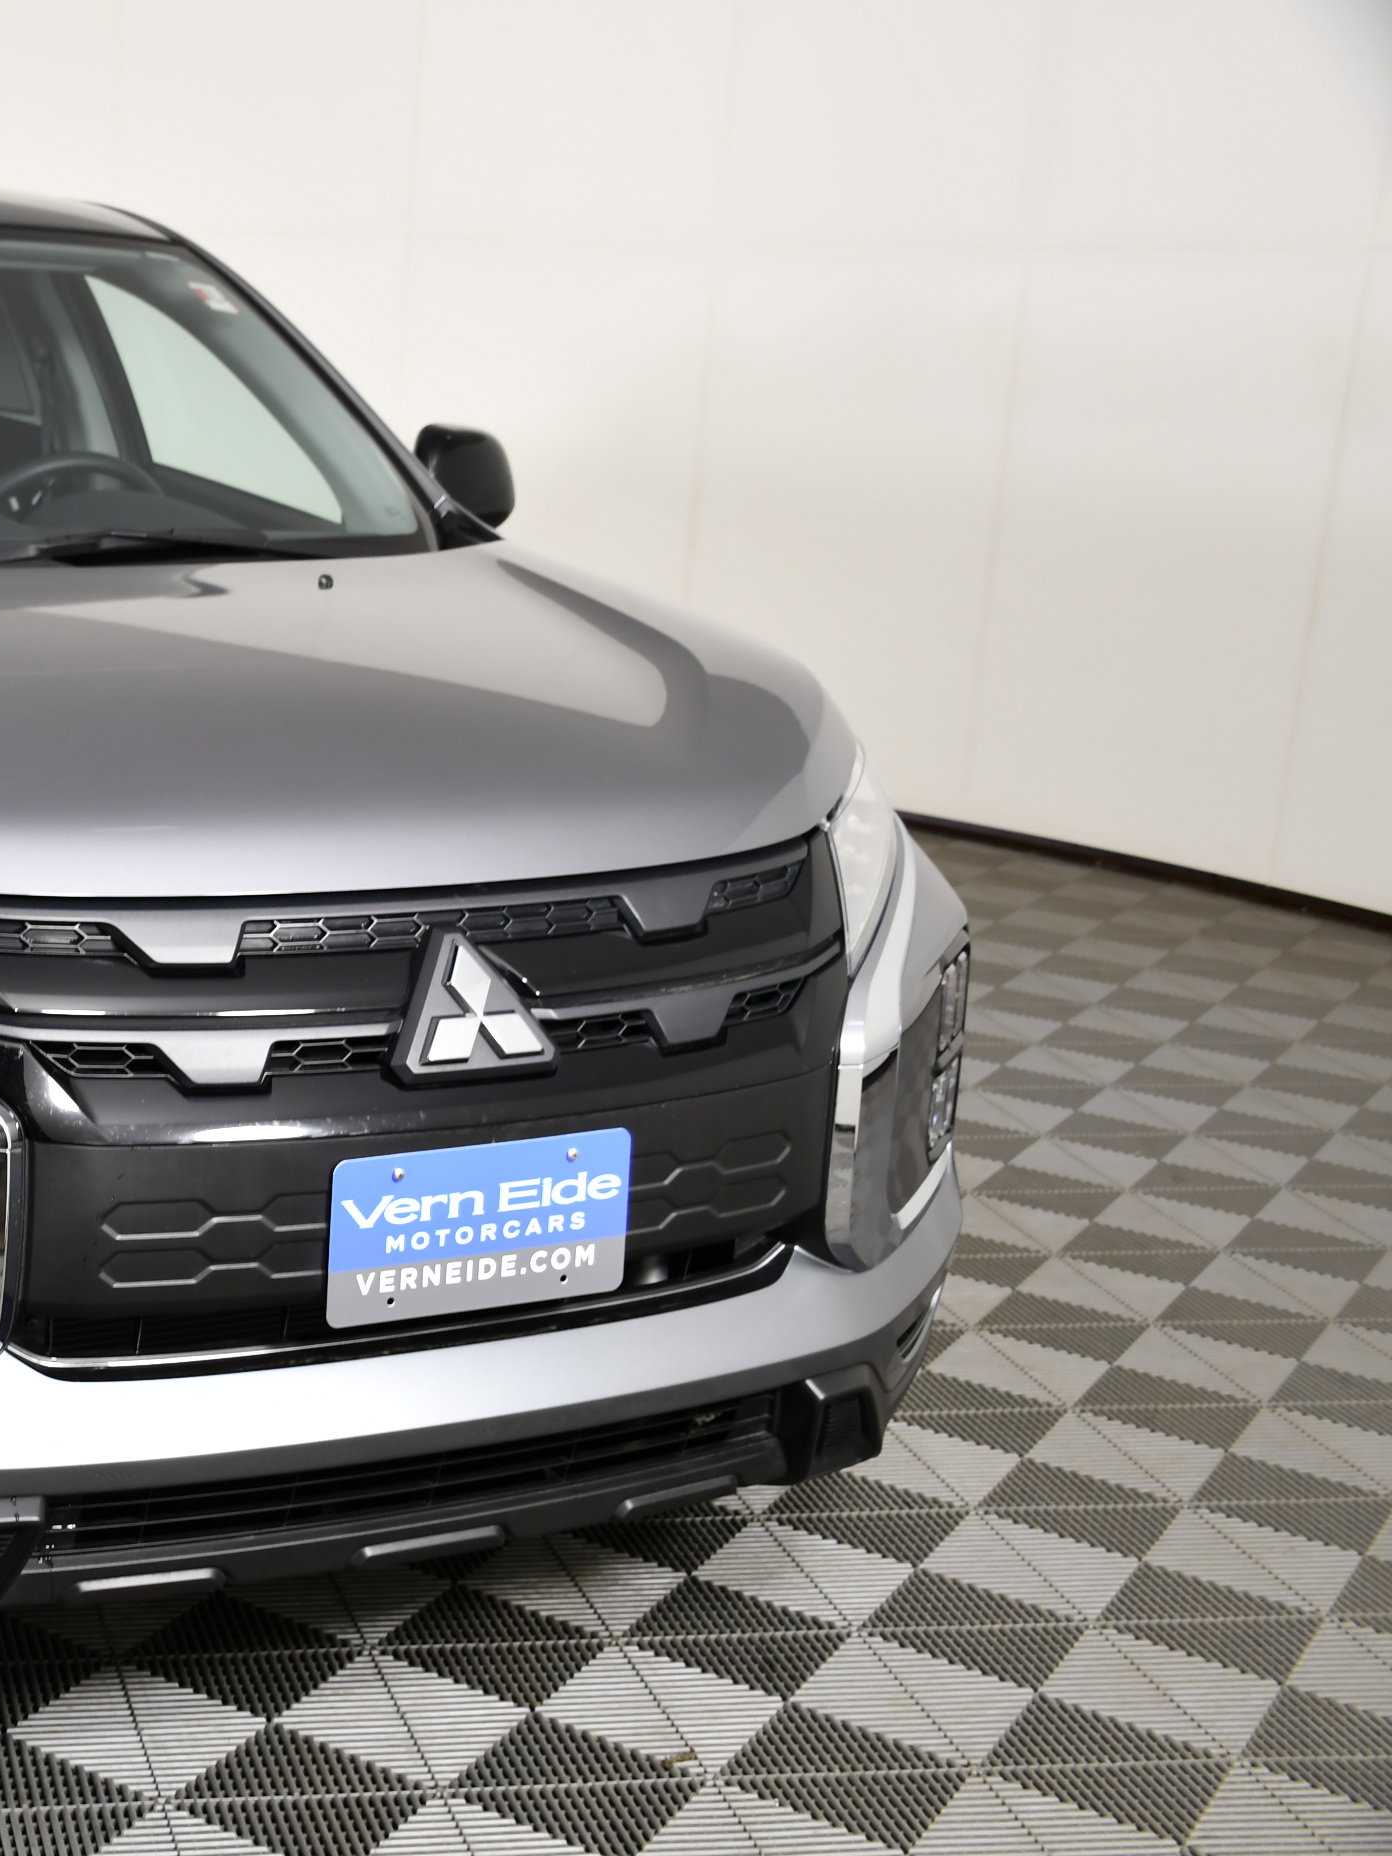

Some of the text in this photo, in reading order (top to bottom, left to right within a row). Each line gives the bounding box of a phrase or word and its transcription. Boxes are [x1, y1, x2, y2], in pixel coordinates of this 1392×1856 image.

[340, 1171, 622, 1230] Vern Eide
[385, 1211, 586, 1254] MOTORCARS
[356, 1243, 596, 1296] VERNEIDE.COM
